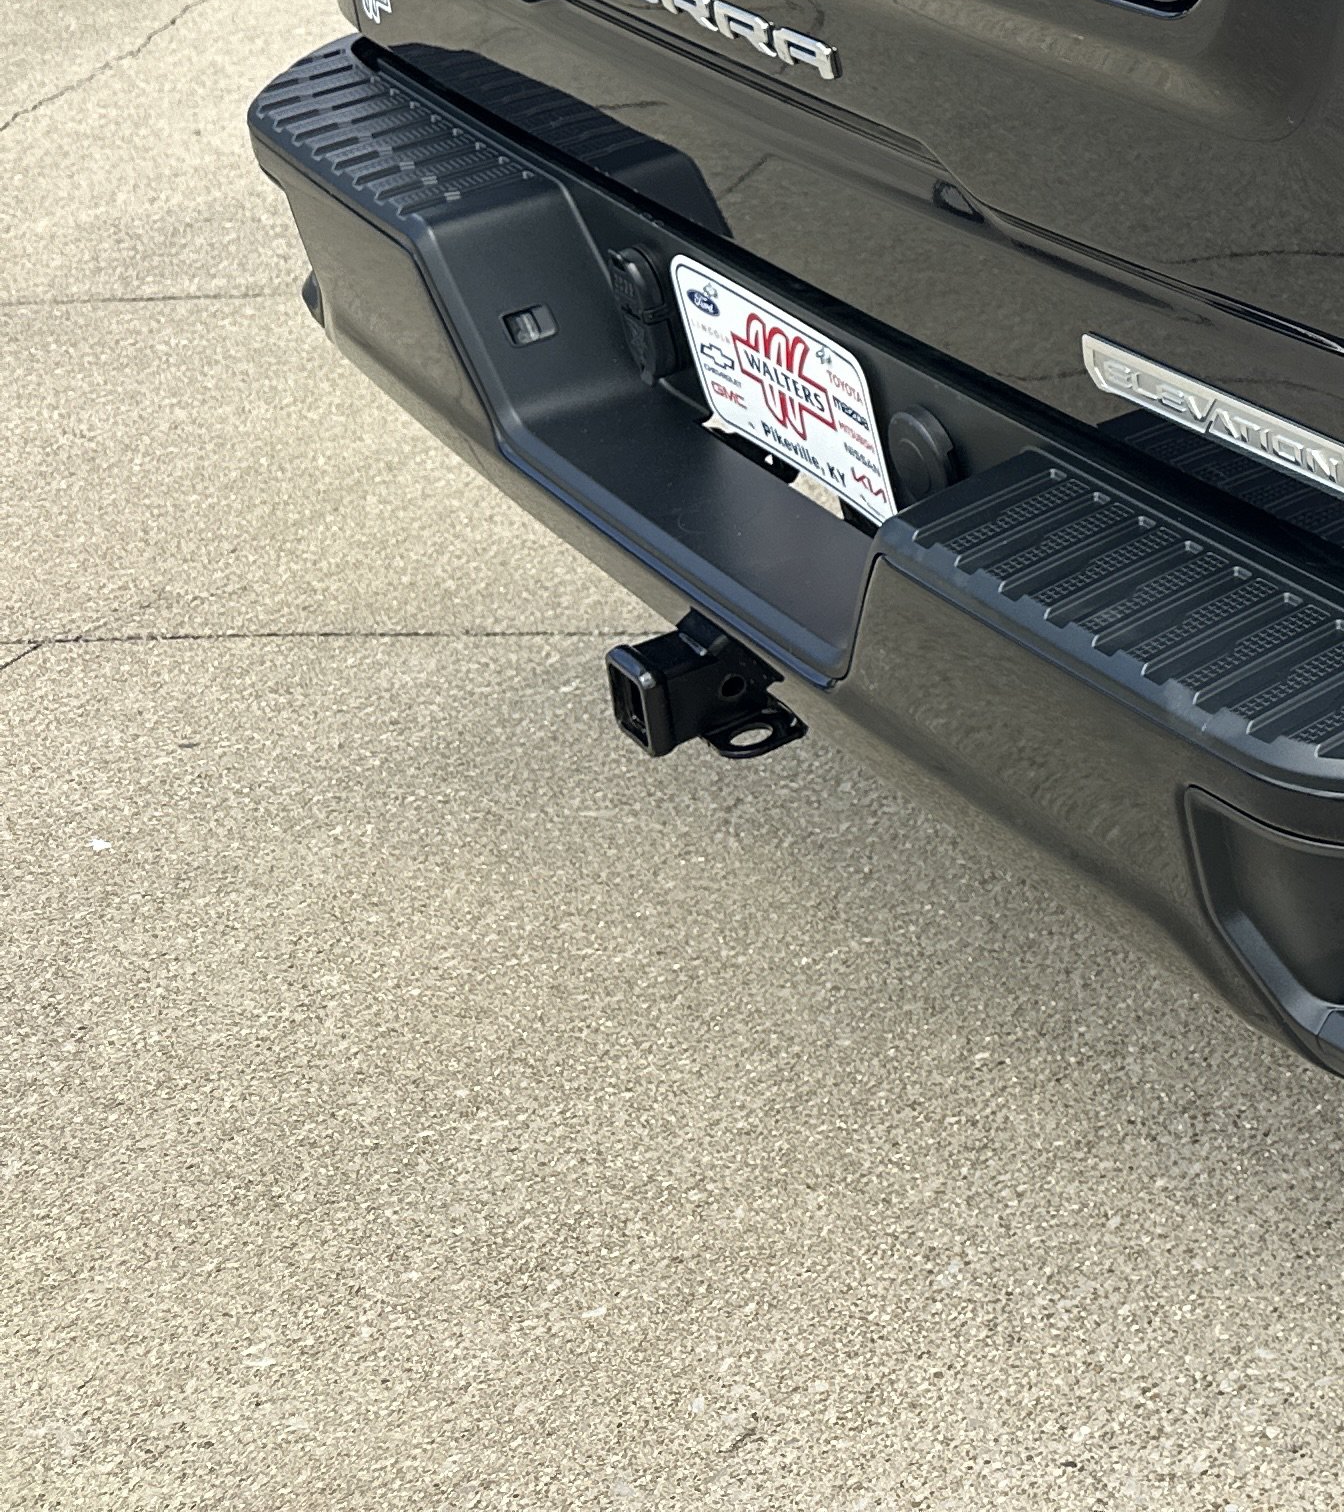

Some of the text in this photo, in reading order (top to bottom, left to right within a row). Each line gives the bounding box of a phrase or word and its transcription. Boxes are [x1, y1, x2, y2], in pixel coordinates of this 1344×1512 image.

[692, 292, 717, 314] Ford
[711, 381, 748, 410] GMC
[743, 349, 825, 412] WALTERS
[826, 369, 863, 406] TOYOTA
[1103, 359, 1344, 486] ELEVATION
[760, 420, 848, 489] Pikeville, KY
[843, 441, 882, 477] NISSAN
